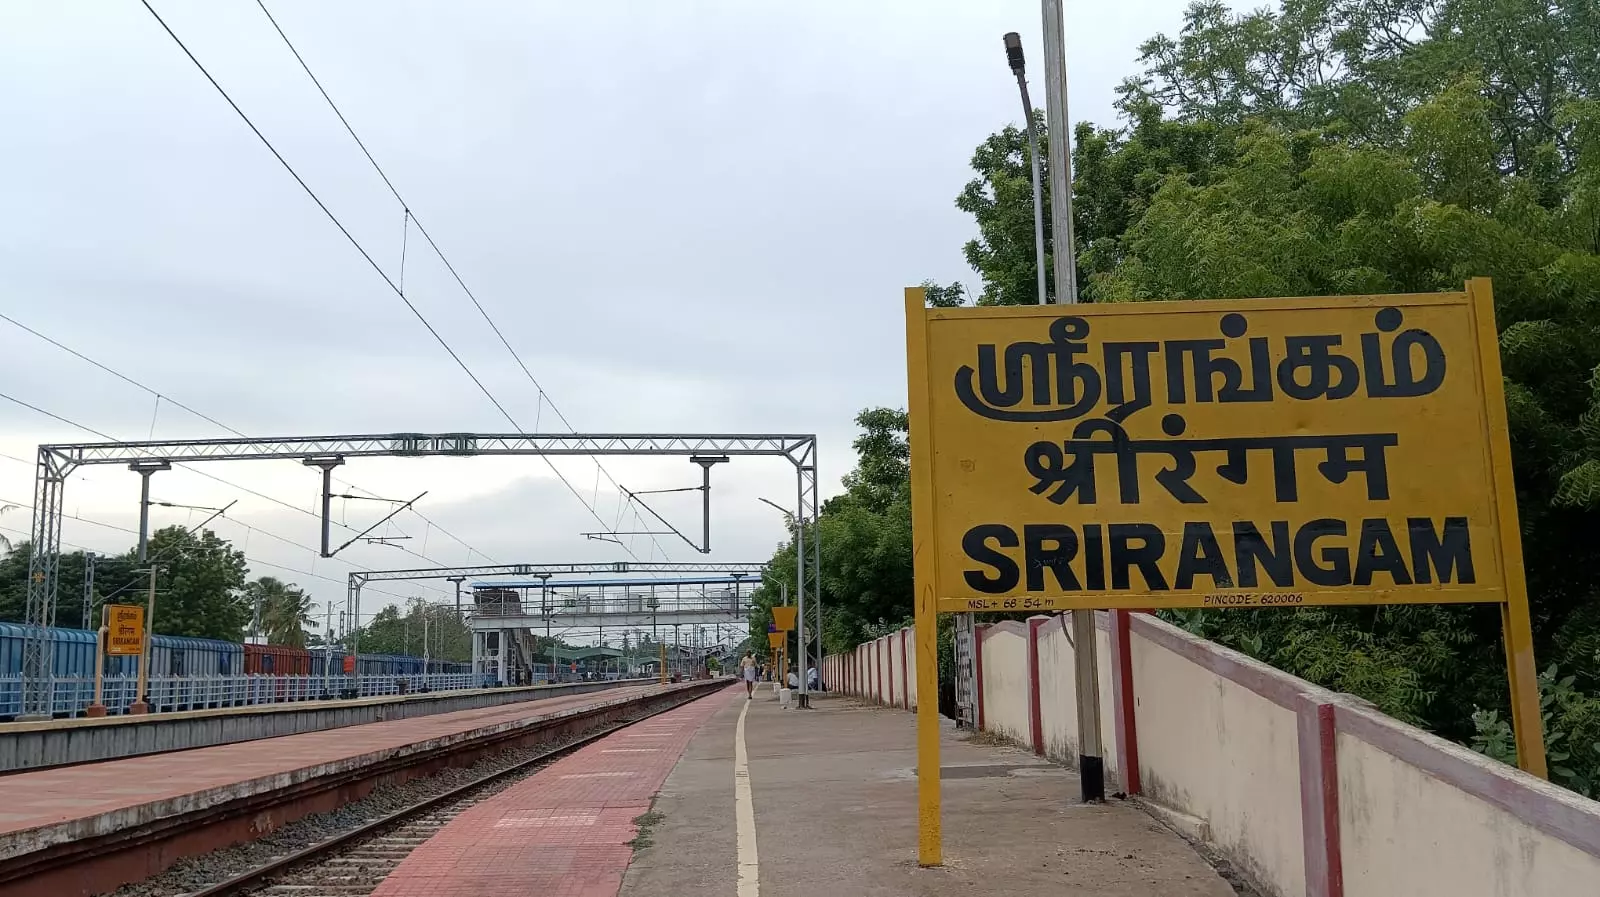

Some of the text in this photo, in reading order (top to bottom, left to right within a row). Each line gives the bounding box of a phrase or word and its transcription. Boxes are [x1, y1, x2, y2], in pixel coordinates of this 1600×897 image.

[1024, 418, 1399, 505] श्रीरंगम
[961, 517, 1477, 594] SRIRANGAM
[1260, 593, 1303, 605] 620006
